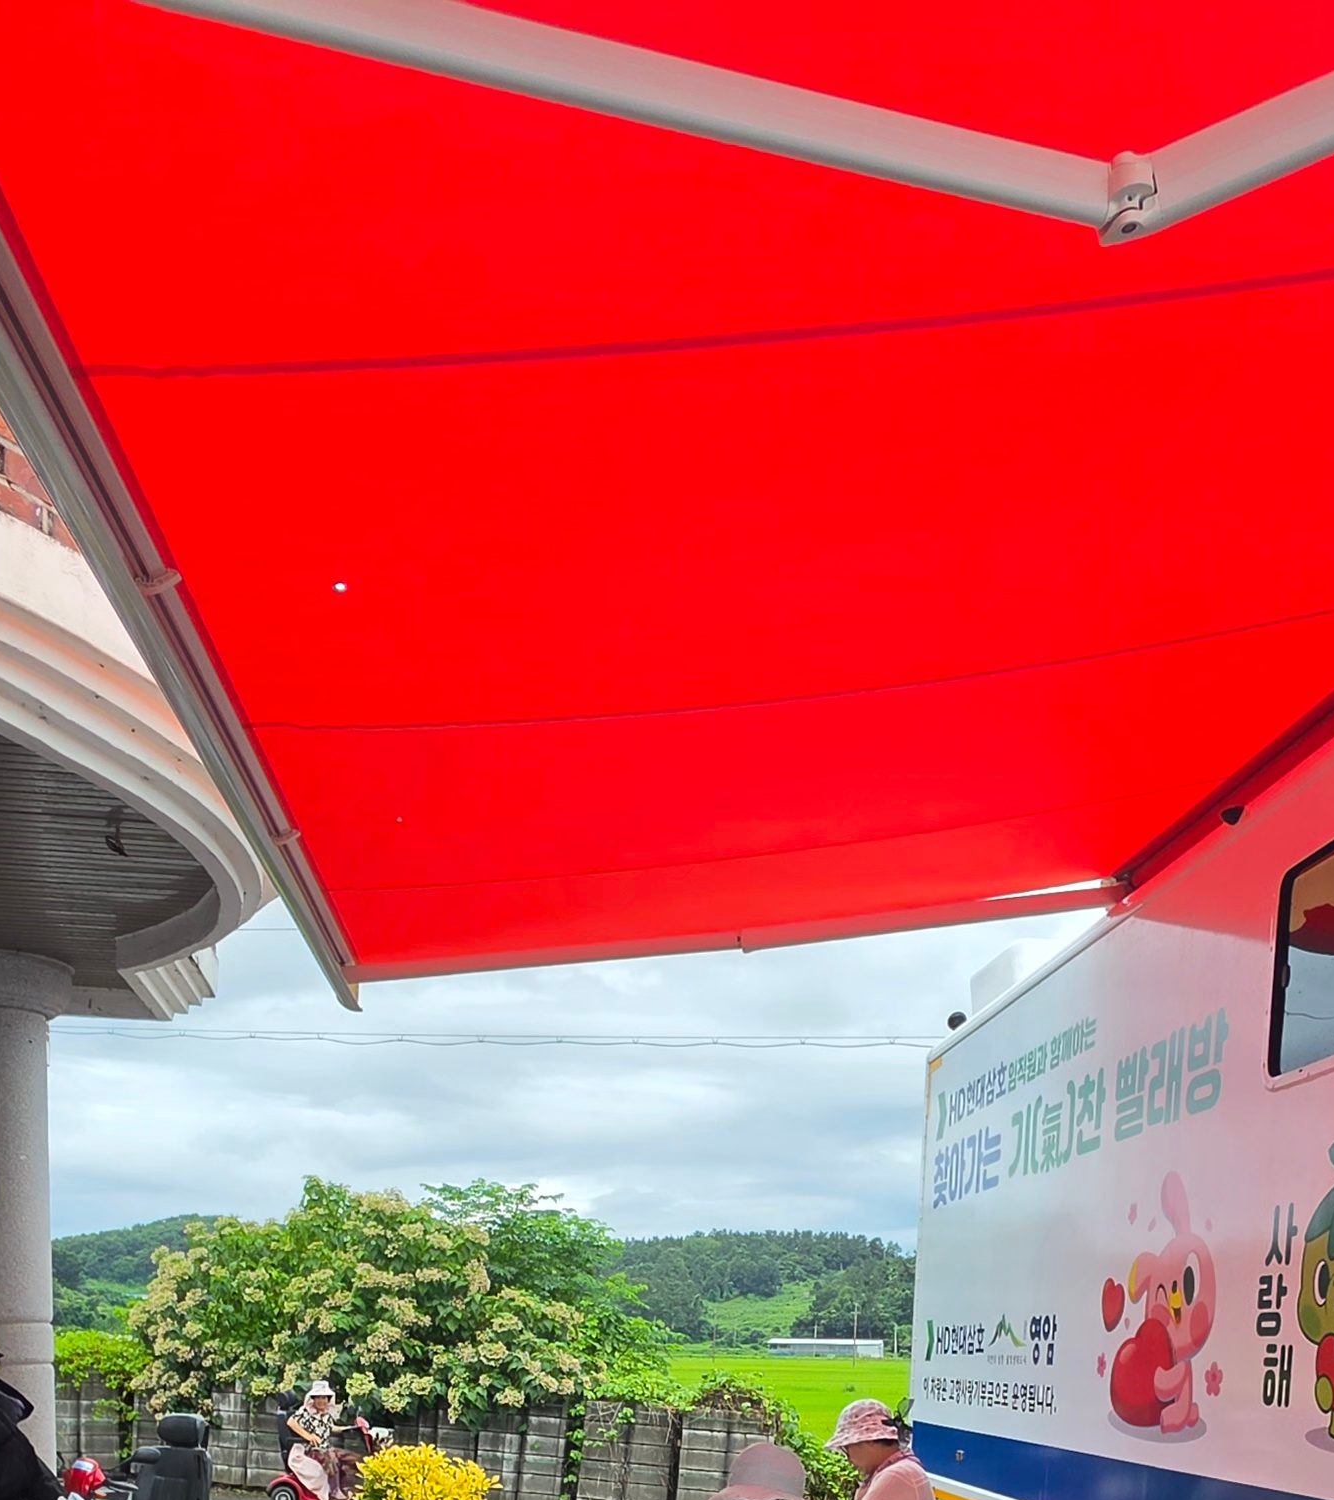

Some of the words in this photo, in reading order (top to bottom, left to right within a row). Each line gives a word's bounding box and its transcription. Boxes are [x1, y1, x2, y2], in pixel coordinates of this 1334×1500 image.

[933, 1126, 1002, 1209] 찾아가는
[1008, 1067, 1106, 1178] 기(氣)찬
[1114, 1007, 1229, 1142] 빨래방
[1256, 1203, 1298, 1408] 사랑해
[935, 1323, 985, 1355] HD현대삼호
[1029, 1314, 1058, 1366] 영암
[930, 1377, 947, 1402] 차량은
[949, 1379, 1009, 1408] 고향사랑기부금으로
[1011, 1382, 1057, 1415] 운영됩니다.
